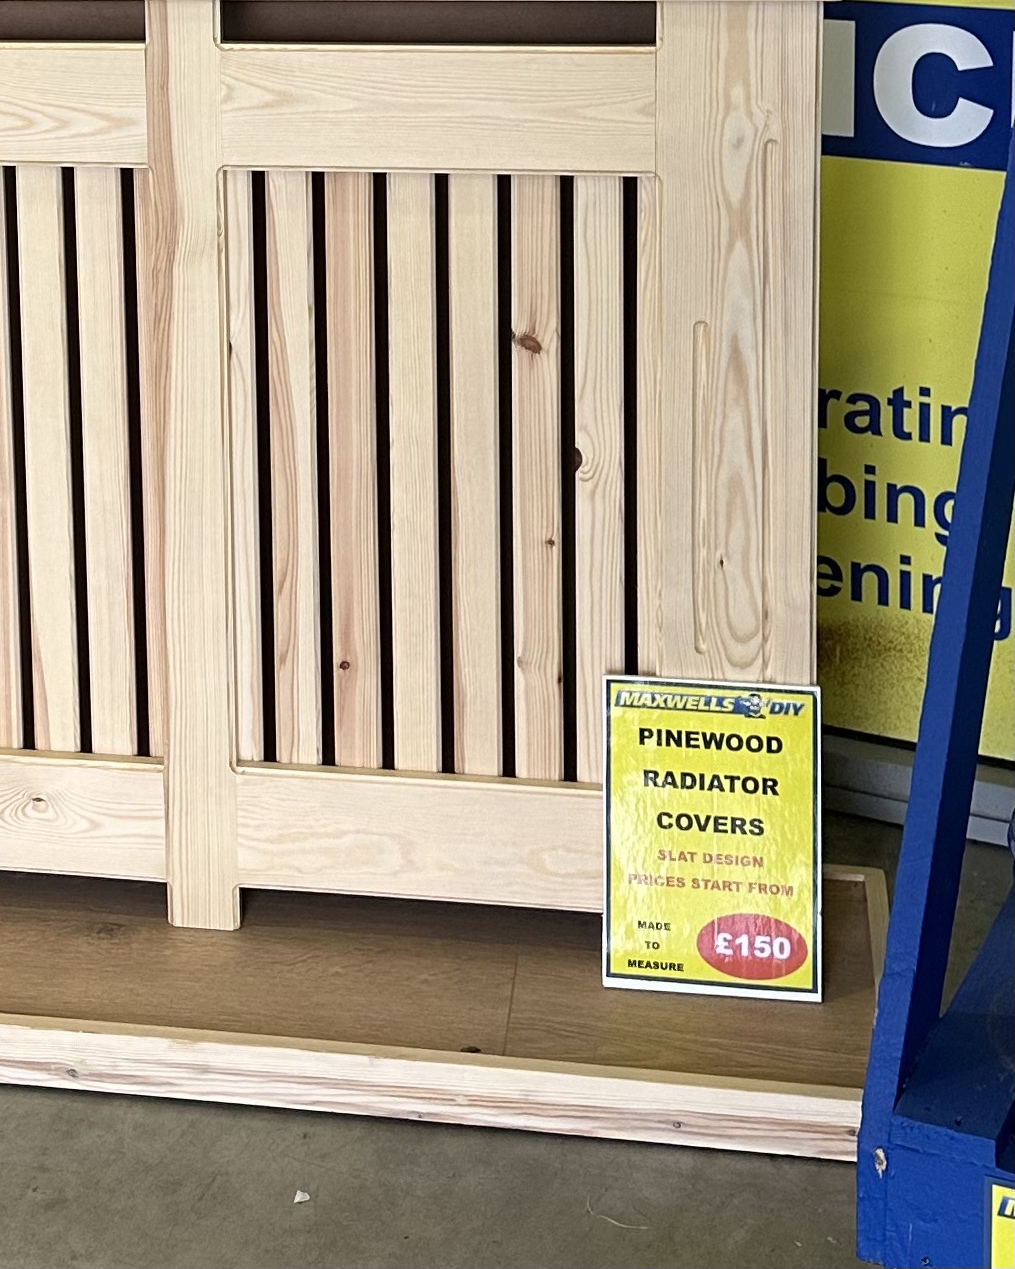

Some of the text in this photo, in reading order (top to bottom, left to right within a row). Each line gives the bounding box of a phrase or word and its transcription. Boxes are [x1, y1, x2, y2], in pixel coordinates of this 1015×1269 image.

[818, 386, 968, 447] ratin
[619, 690, 805, 716] MAXWELLS DIY
[639, 728, 783, 754] PINEWOOD
[643, 770, 779, 796] RADIATOR
[656, 812, 765, 836] COVERS
[657, 849, 764, 868] SLAT DESIGN
[628, 873, 794, 897] PRICES START FROM
[637, 920, 670, 931] MADE
[645, 941, 660, 950] TO
[715, 932, 791, 959] £150
[627, 959, 684, 972] MEASURE
